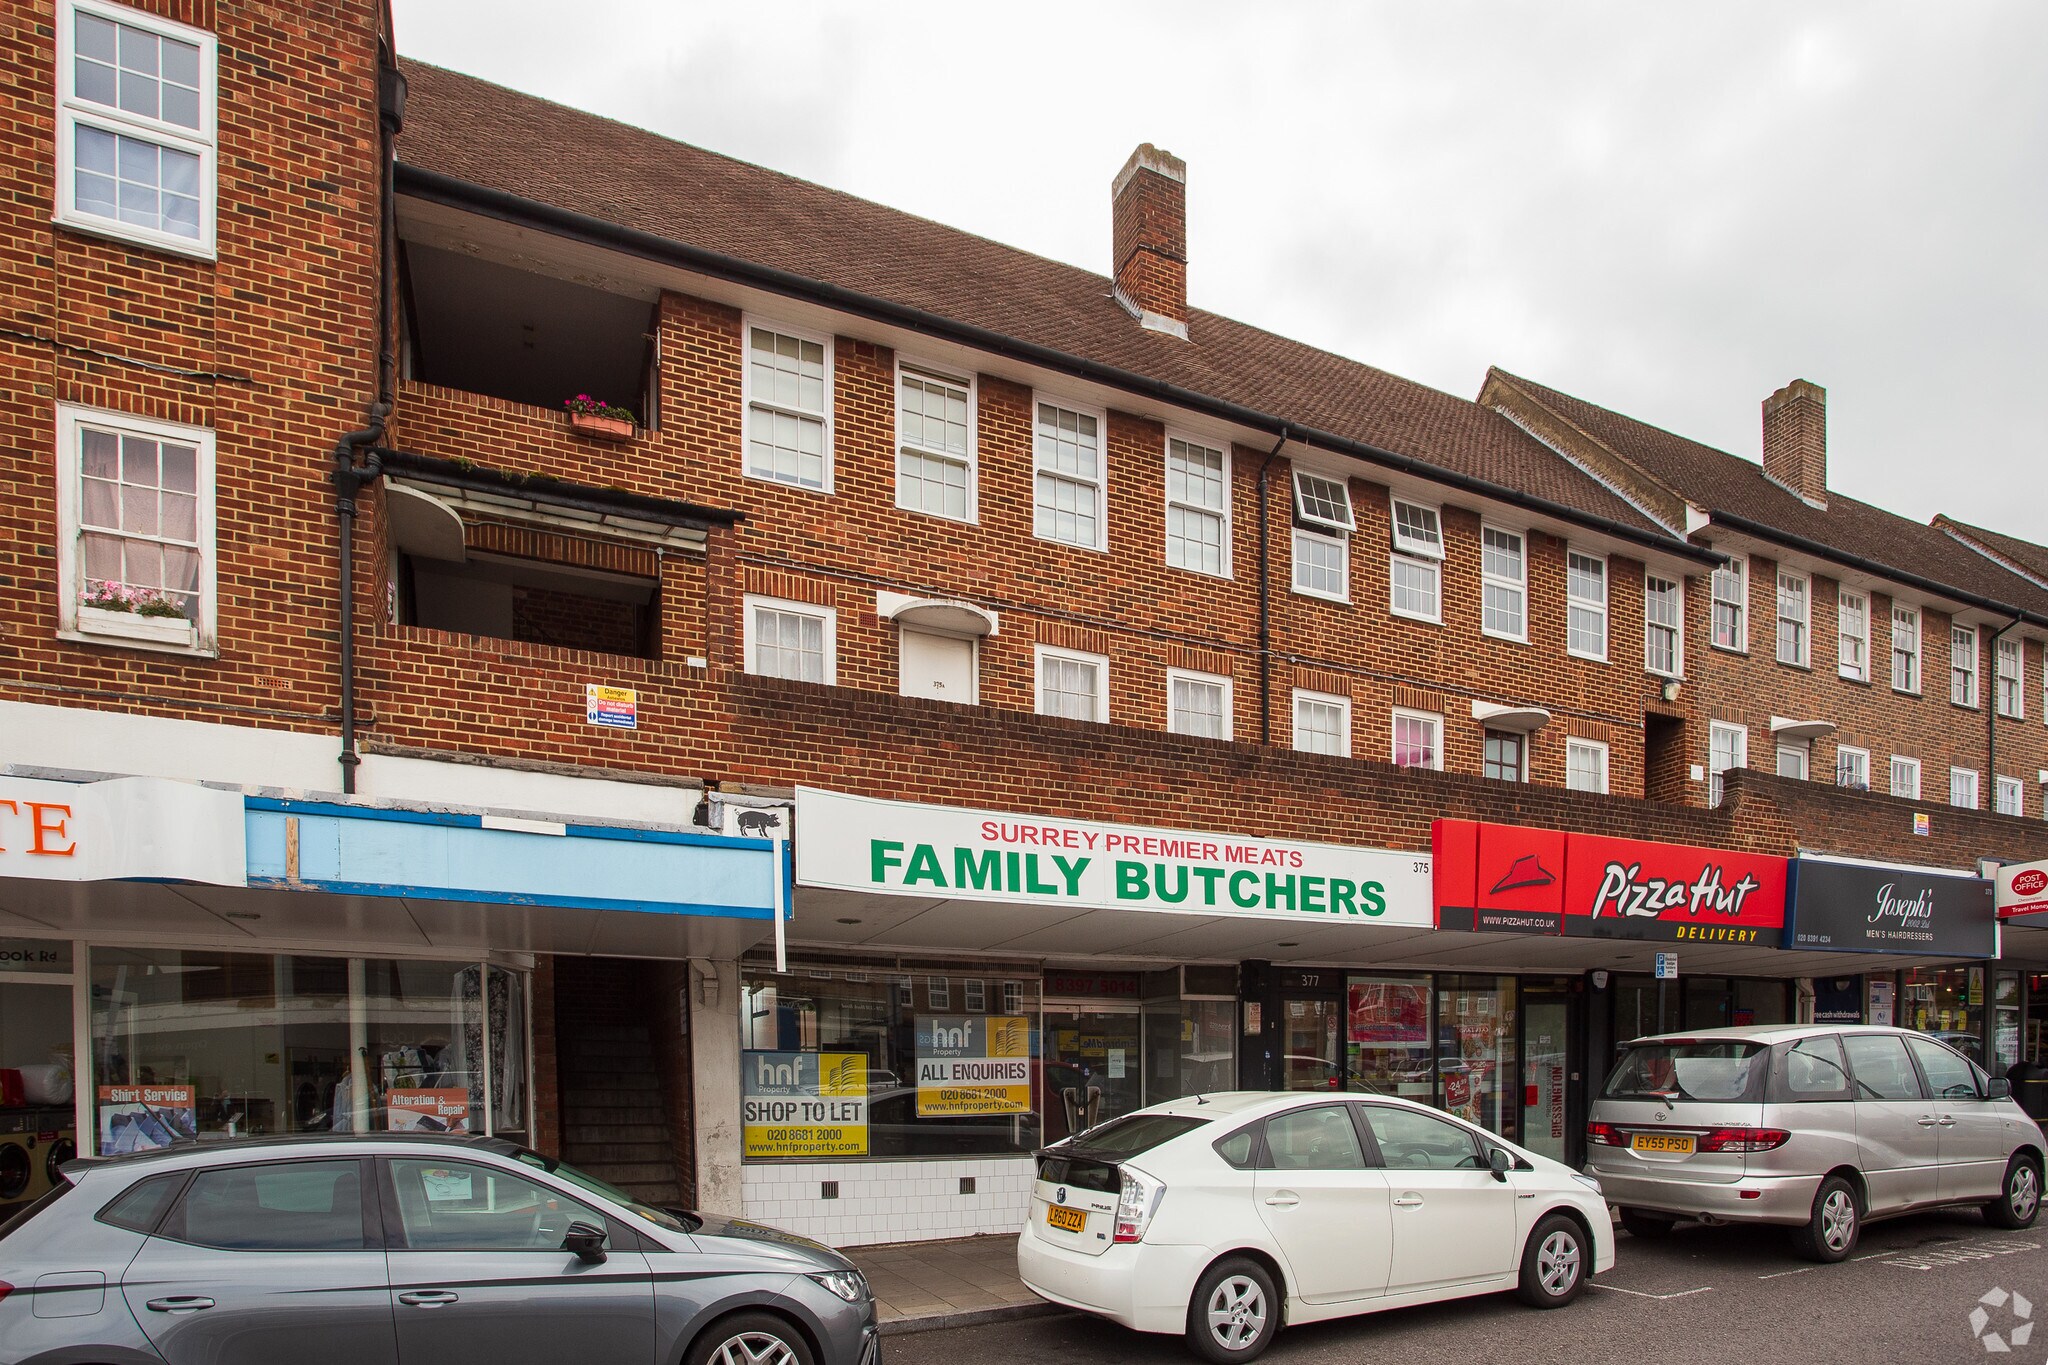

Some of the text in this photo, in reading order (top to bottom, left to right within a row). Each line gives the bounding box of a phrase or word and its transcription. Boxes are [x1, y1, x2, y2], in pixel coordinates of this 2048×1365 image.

[604, 688, 627, 697] Danger
[615, 701, 634, 709] disturb
[980, 821, 1304, 868] SURREY PREMIER MEATS
[1412, 861, 1429, 874] 375
[870, 838, 1386, 917] FAMILY BUTCHERS
[2019, 873, 2041, 883] POST
[1592, 863, 1758, 920] Pizza Hut
[2014, 880, 2044, 891] OFFICE
[1867, 882, 1933, 927] Joseph's
[2011, 903, 2048, 913] Travel Money
[1482, 915, 1555, 928] WWW.PIZZAHUT.CO.UK
[1676, 926, 1758, 942] DELIVERY
[1797, 933, 1806, 942] 020
[1866, 929, 1934, 941] MEN'S HAIRDRESSERS
[0, 949, 57, 963] ook Rd
[1055, 978, 1093, 992] 8397
[1100, 979, 1136, 994] 5014
[1301, 974, 1319, 987] 377
[932, 1019, 972, 1048] hnf
[932, 1048, 962, 1057] Property
[758, 1055, 803, 1086] hnf
[920, 1062, 1027, 1081] ALL ENQUIRIES
[111, 1088, 188, 1102] Shirt Service
[758, 1086, 791, 1094] Property
[940, 1087, 1007, 1100] 020 8681 2000
[391, 1094, 446, 1105] Alteration &
[924, 1100, 1023, 1112] www.hnfproperty.com
[1551, 1066, 1563, 1139] CHESSINGTON
[437, 1104, 465, 1116] Repair
[744, 1101, 862, 1122] SHOP TO LET
[766, 1128, 842, 1141] 020 8681 2000
[748, 1142, 860, 1153] www.hnfproperty.com
[1637, 1136, 1689, 1150] EY55 PSO
[1049, 1207, 1083, 1228] LR60 ZZA
